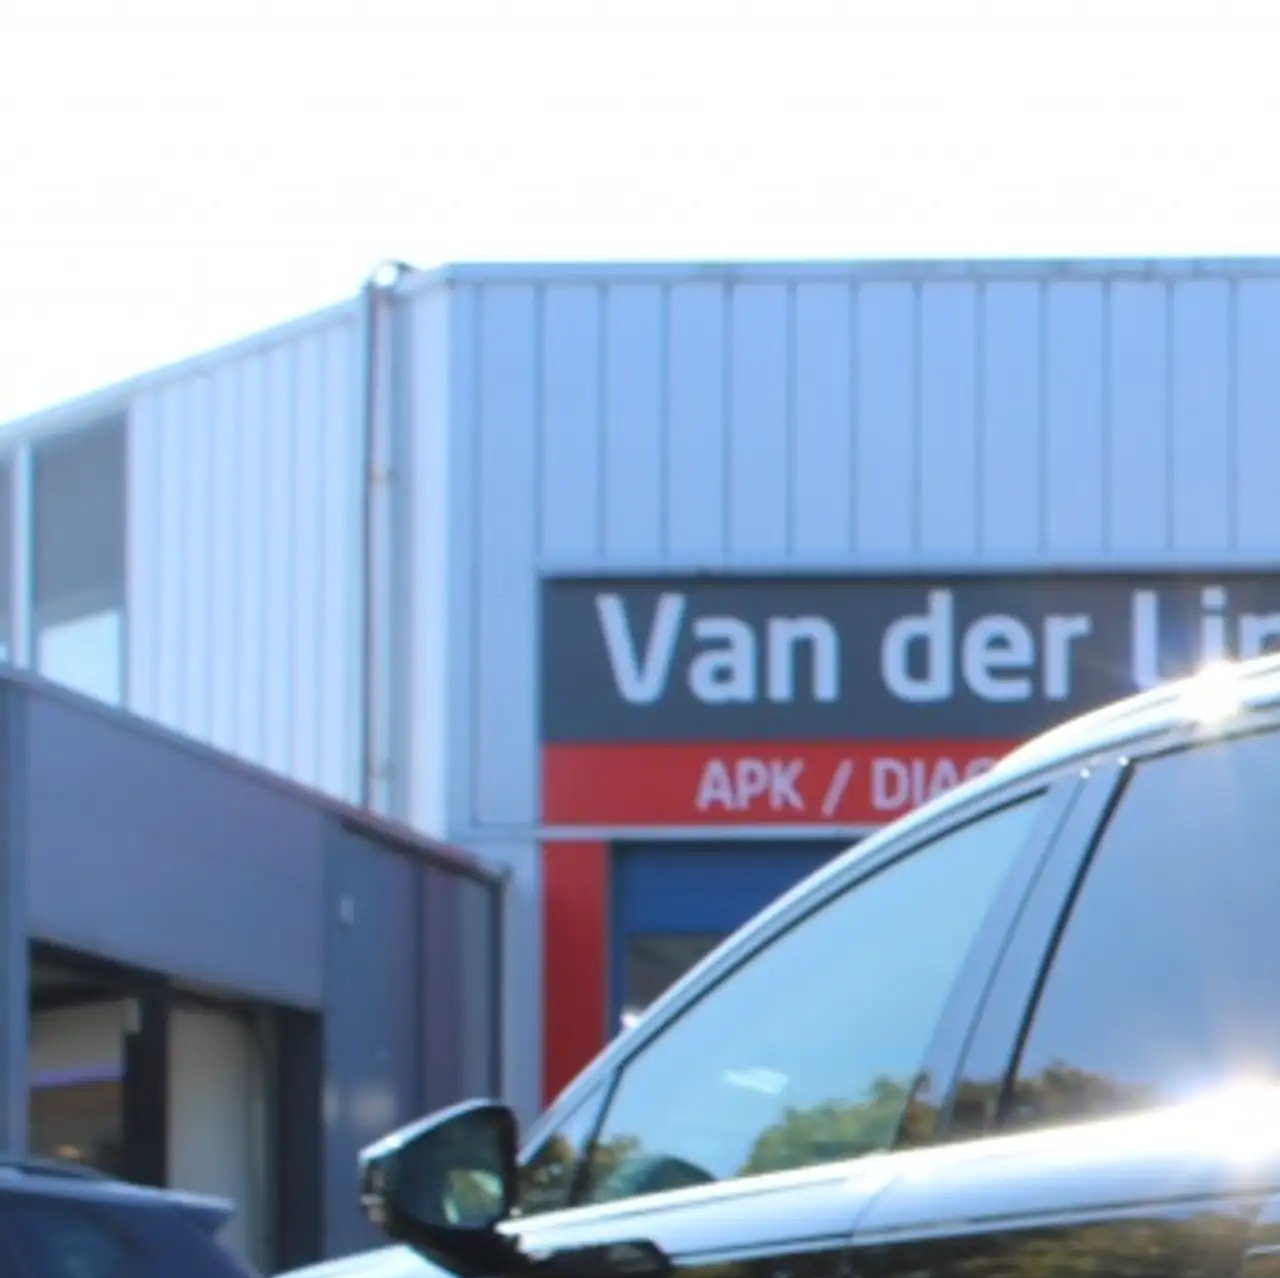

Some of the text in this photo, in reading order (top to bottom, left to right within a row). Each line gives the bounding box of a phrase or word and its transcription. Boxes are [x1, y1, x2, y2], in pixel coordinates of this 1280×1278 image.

[595, 591, 839, 703] Van
[880, 589, 1089, 703] der
[696, 757, 804, 811] APK
[820, 760, 854, 817] /
